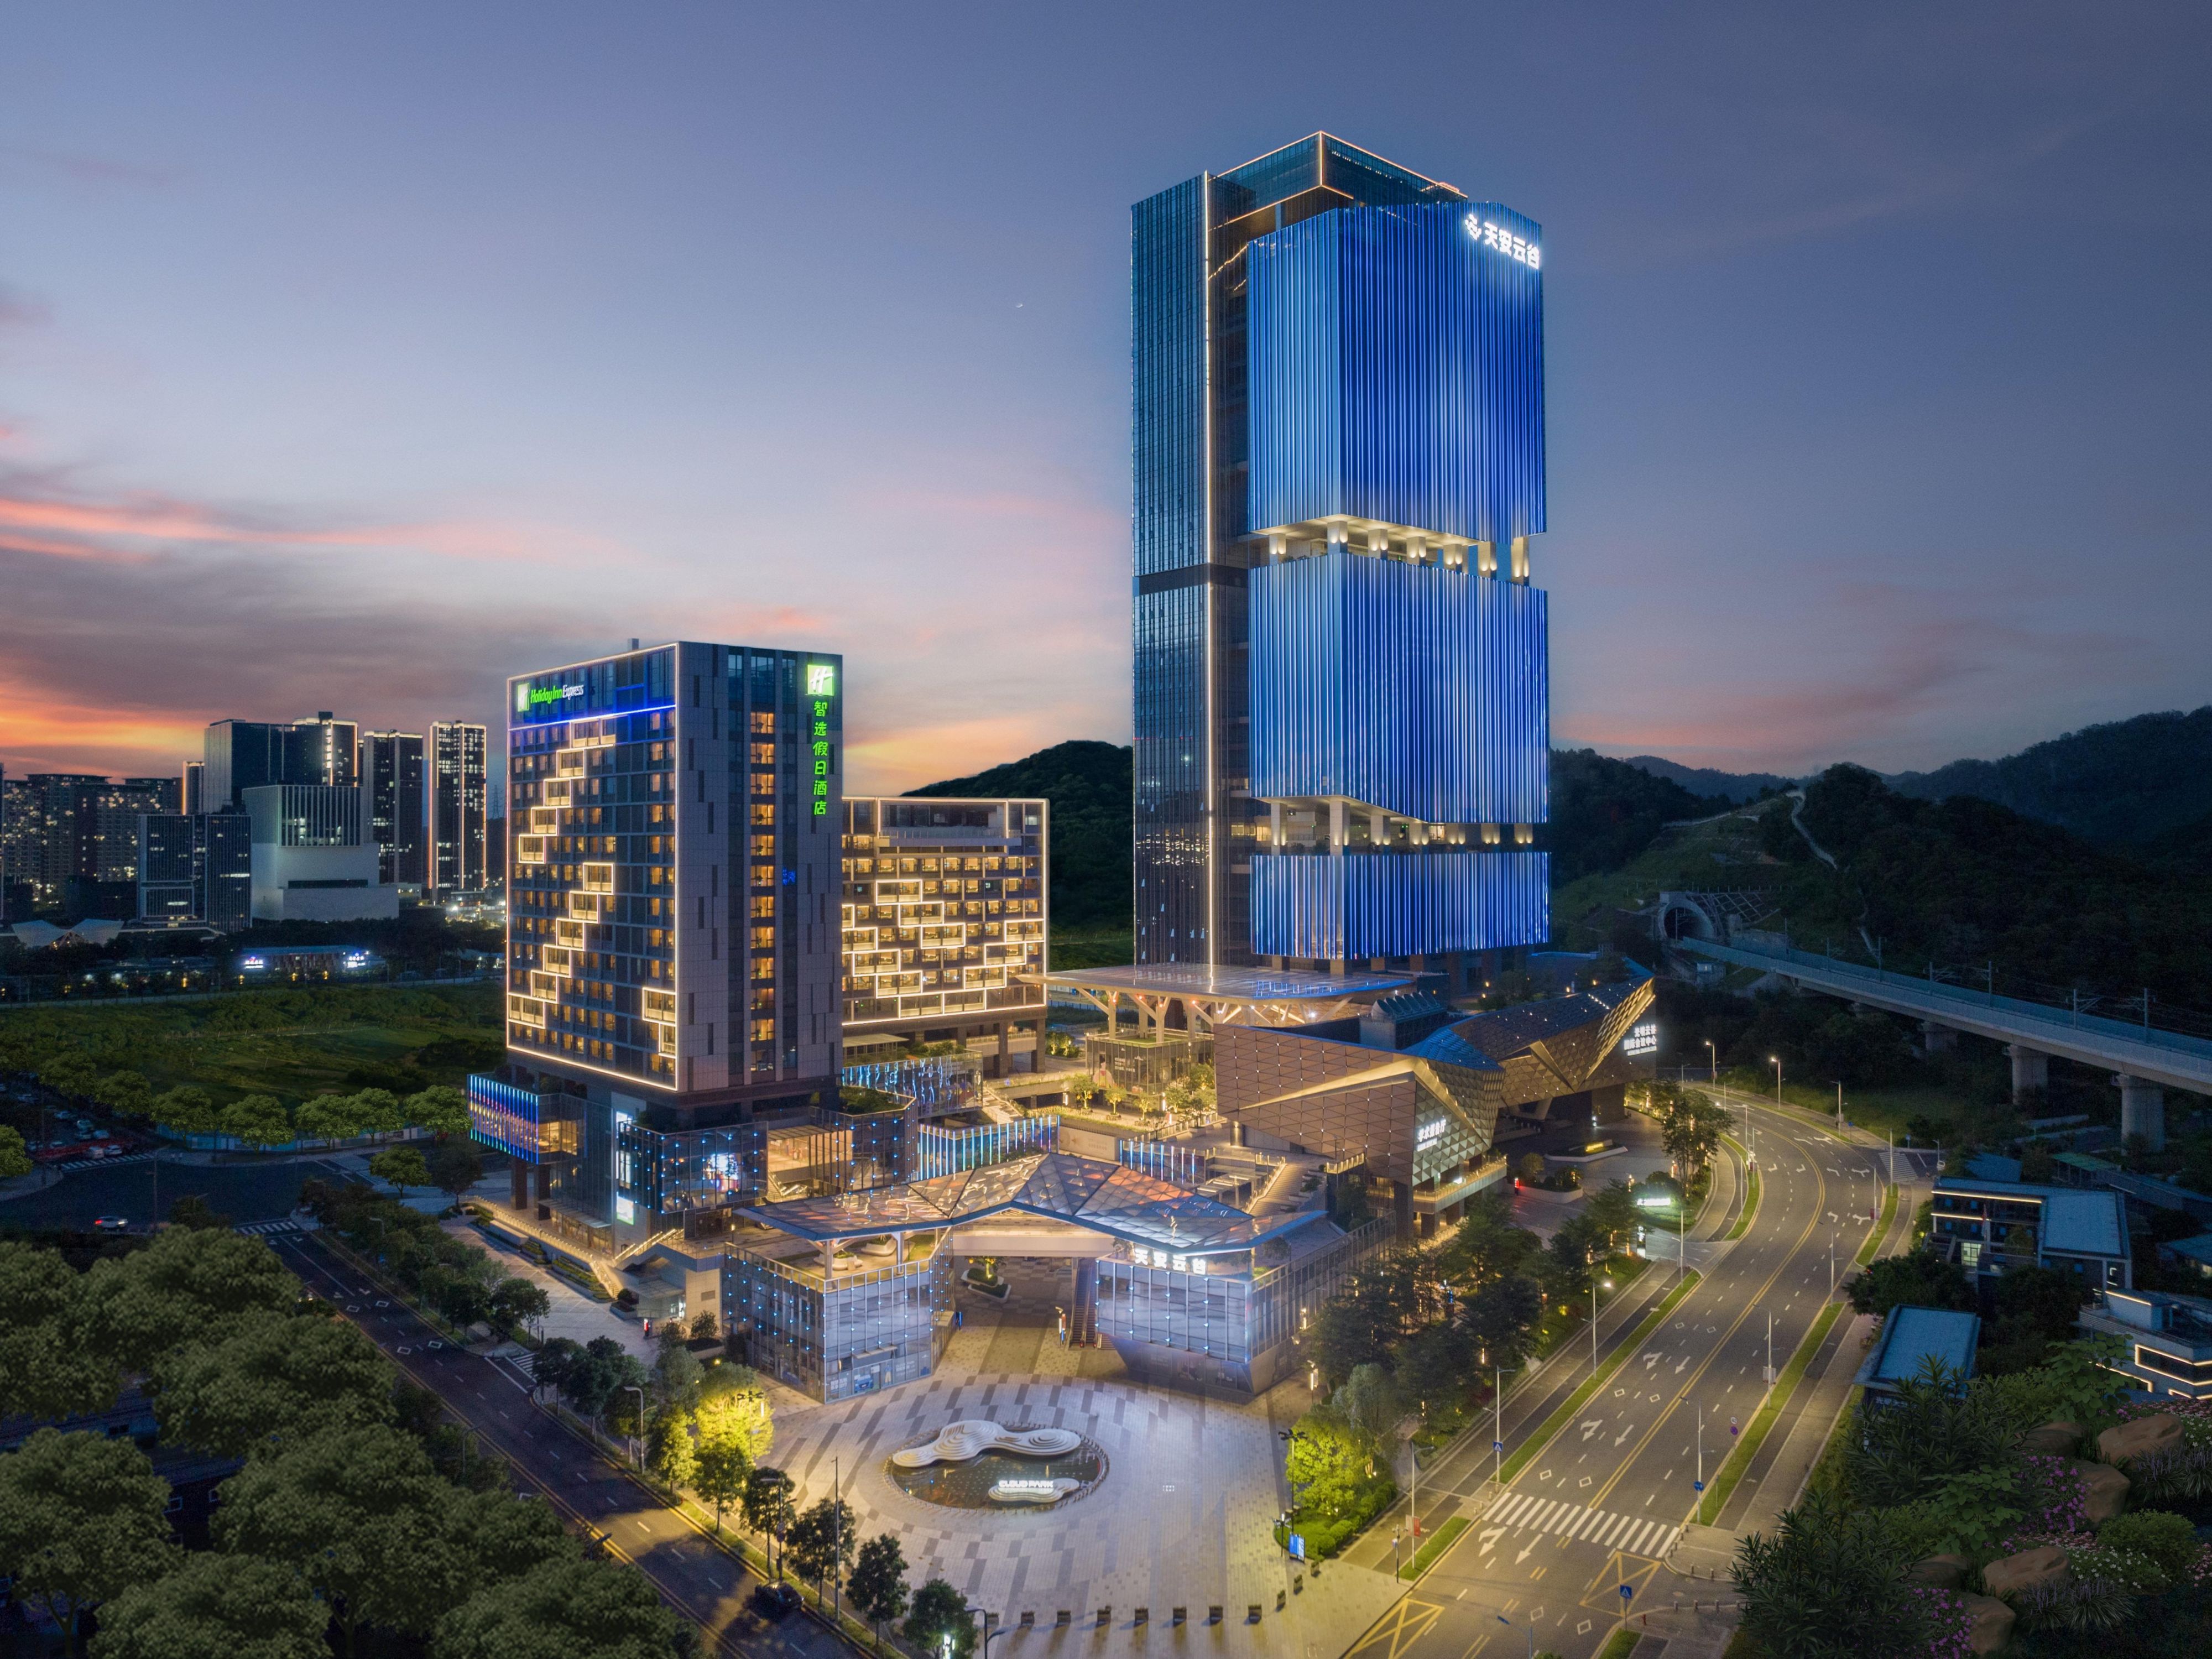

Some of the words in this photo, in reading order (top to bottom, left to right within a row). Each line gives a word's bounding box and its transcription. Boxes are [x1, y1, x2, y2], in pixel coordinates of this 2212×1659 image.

[531, 687, 552, 704] Holiday
[552, 685, 563, 700] Inn
[562, 685, 584, 700] Express
[812, 700, 828, 816] 智选假日酒店
[1029, 1480, 1053, 1488] PARK
